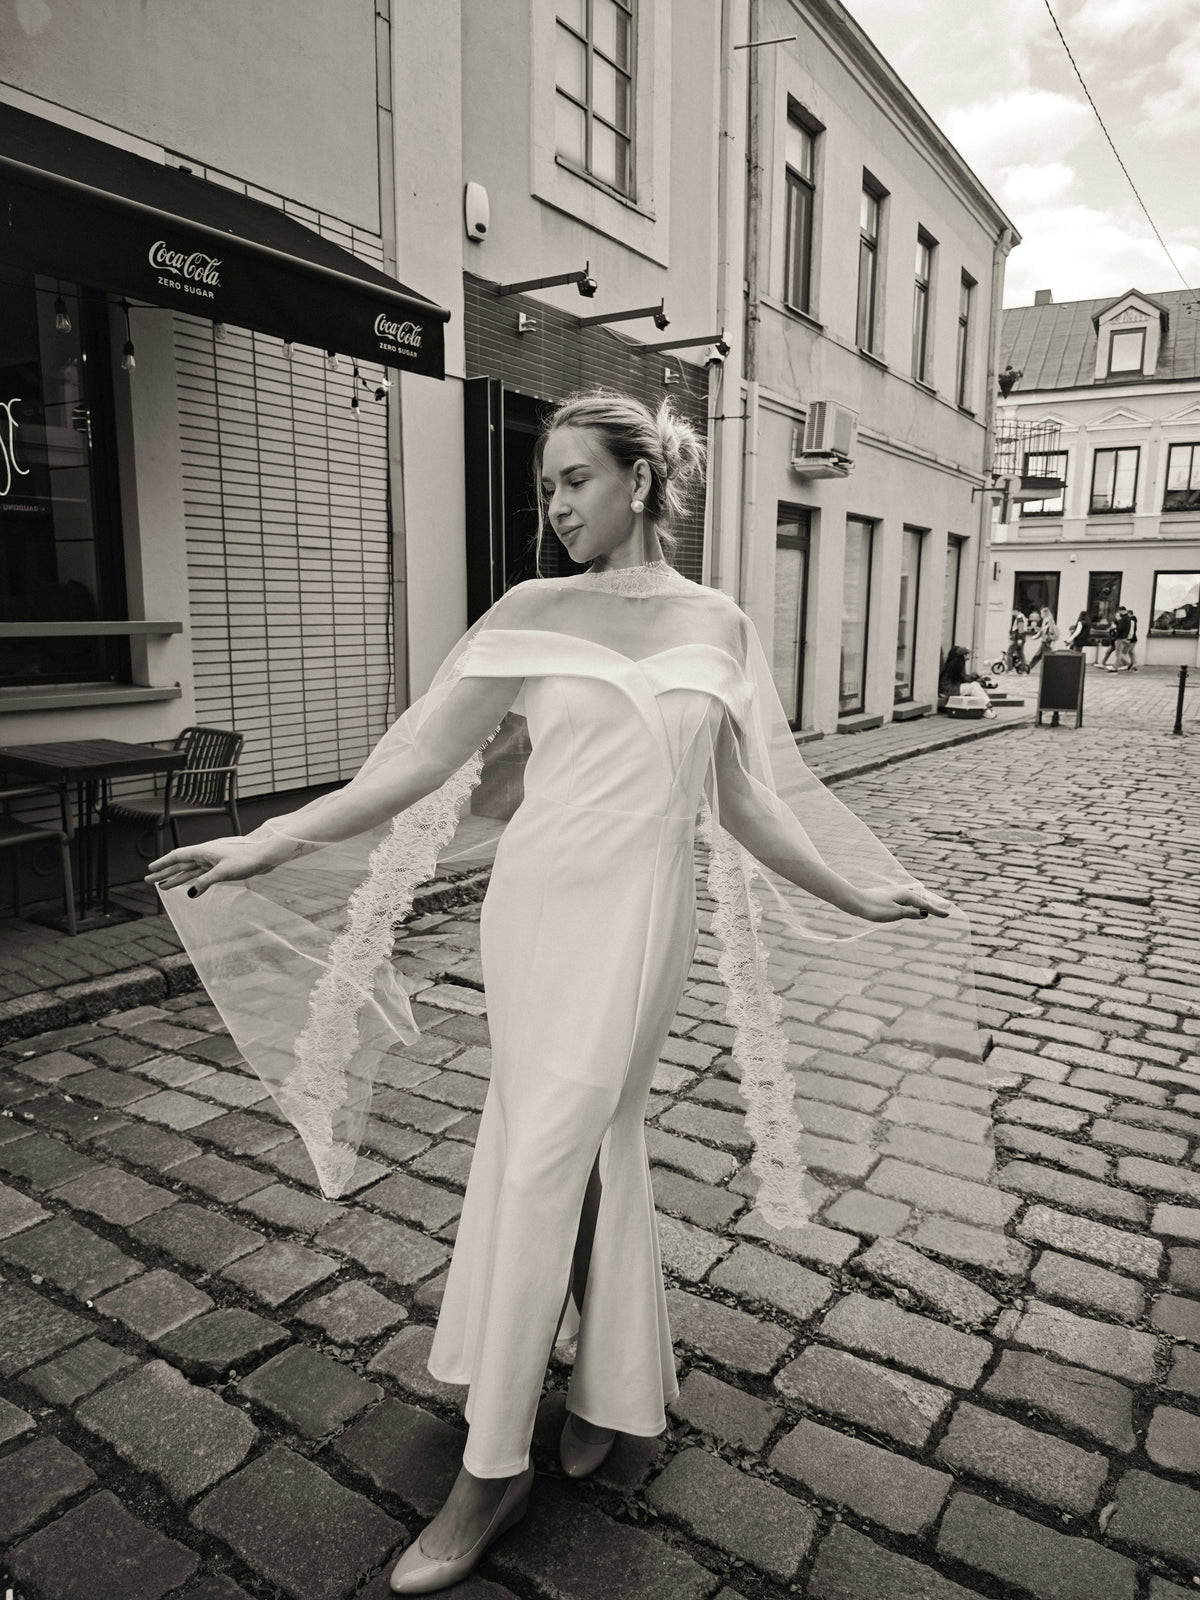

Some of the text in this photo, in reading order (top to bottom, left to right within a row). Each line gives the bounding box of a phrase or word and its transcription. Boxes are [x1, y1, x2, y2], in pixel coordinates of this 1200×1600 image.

[148, 240, 223, 287] Coca-Cola
[157, 276, 215, 300] ZERO SUGAR
[374, 313, 423, 348] Coca-Cola
[379, 342, 418, 358] ZERO SUGAR
